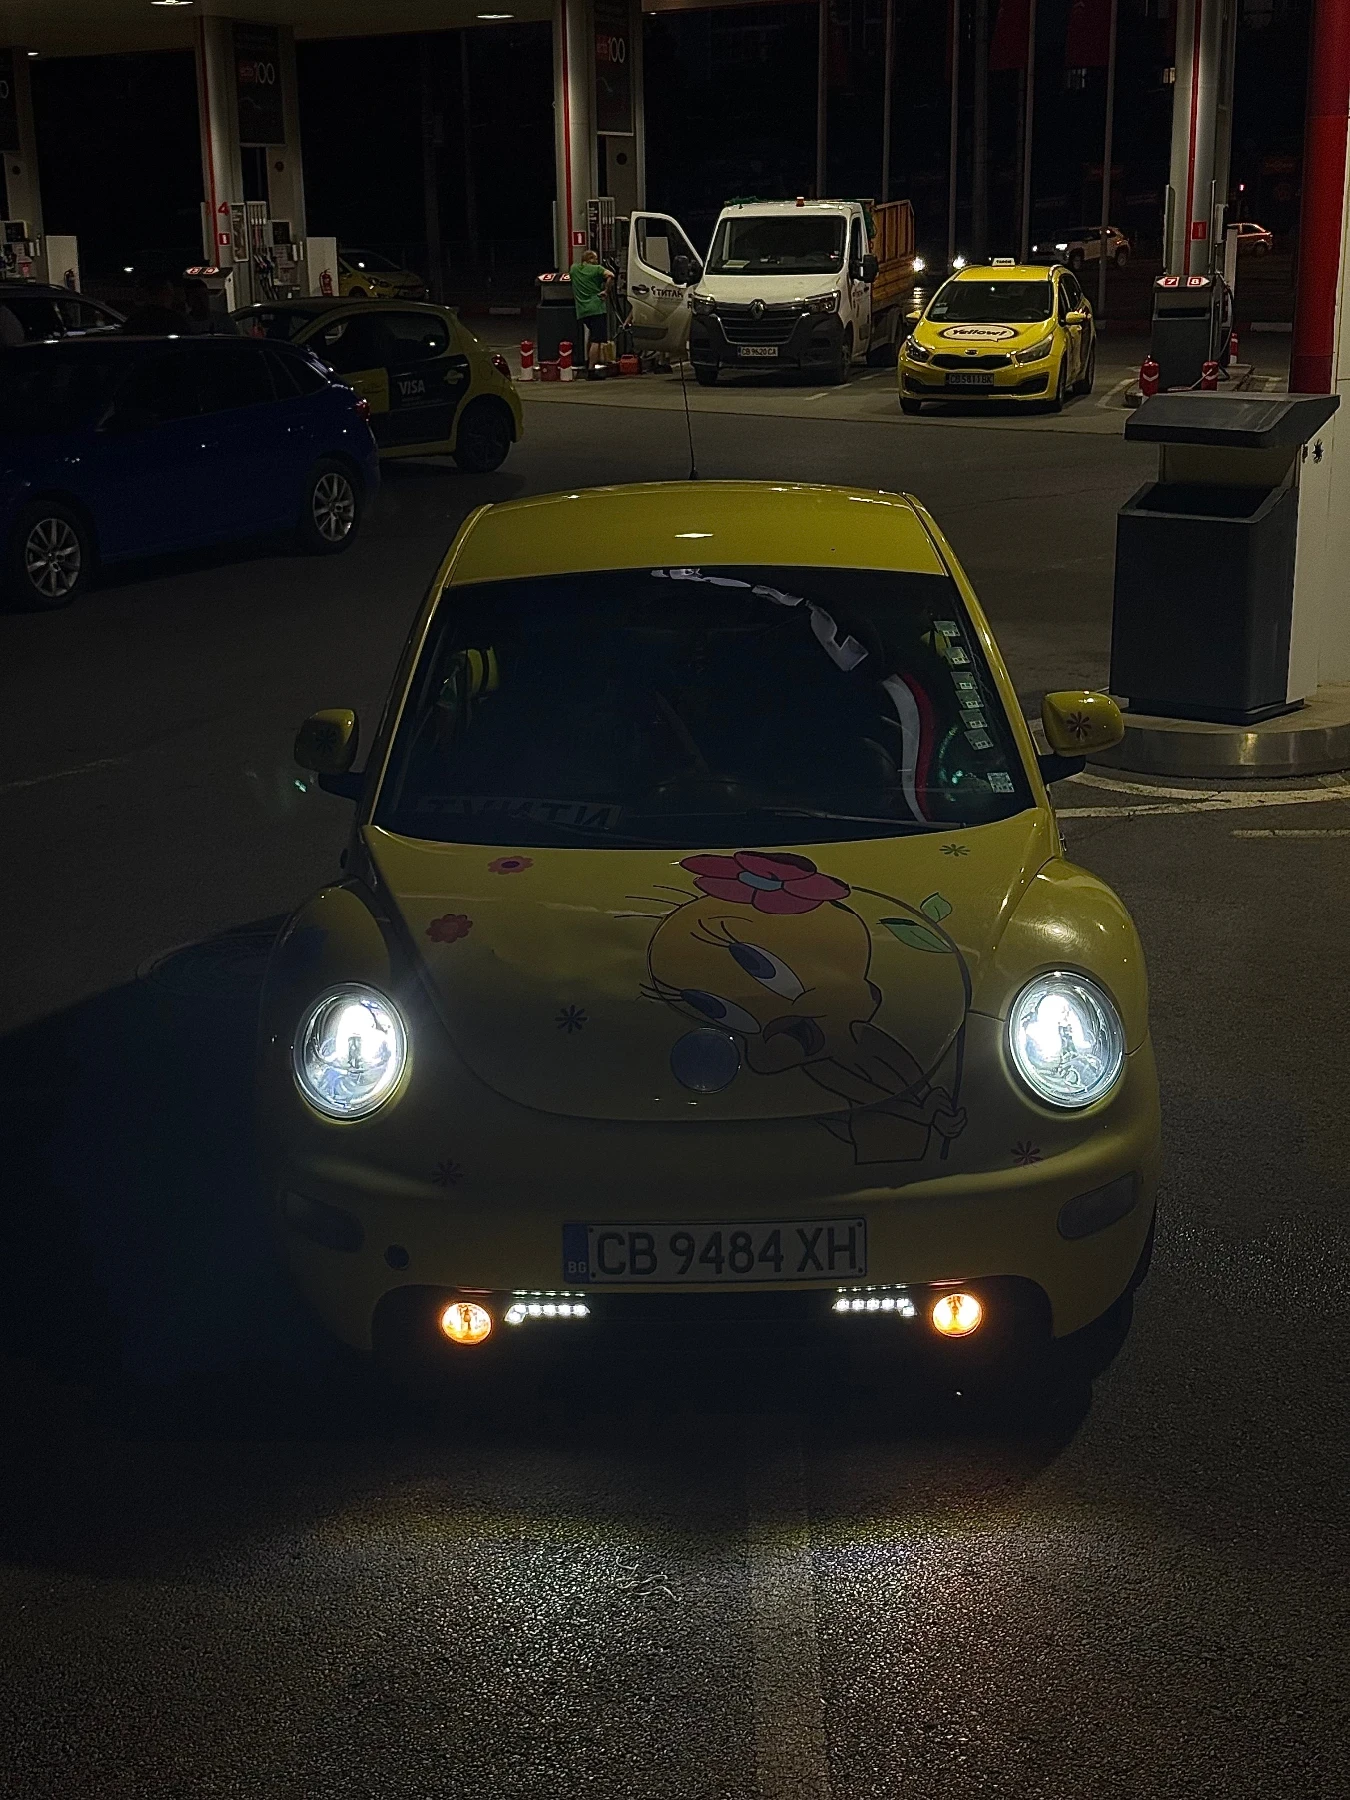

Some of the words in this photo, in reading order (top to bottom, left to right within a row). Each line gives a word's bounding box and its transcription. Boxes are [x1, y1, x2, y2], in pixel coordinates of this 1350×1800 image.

[608, 36, 625, 63] 100
[253, 61, 275, 85] 100
[218, 202, 229, 214] 4
[398, 380, 426, 396] VISA
[597, 1232, 657, 1275] CB
[669, 1229, 784, 1275] 9484
[796, 1226, 857, 1272] XH
[567, 1261, 587, 1274] BG
